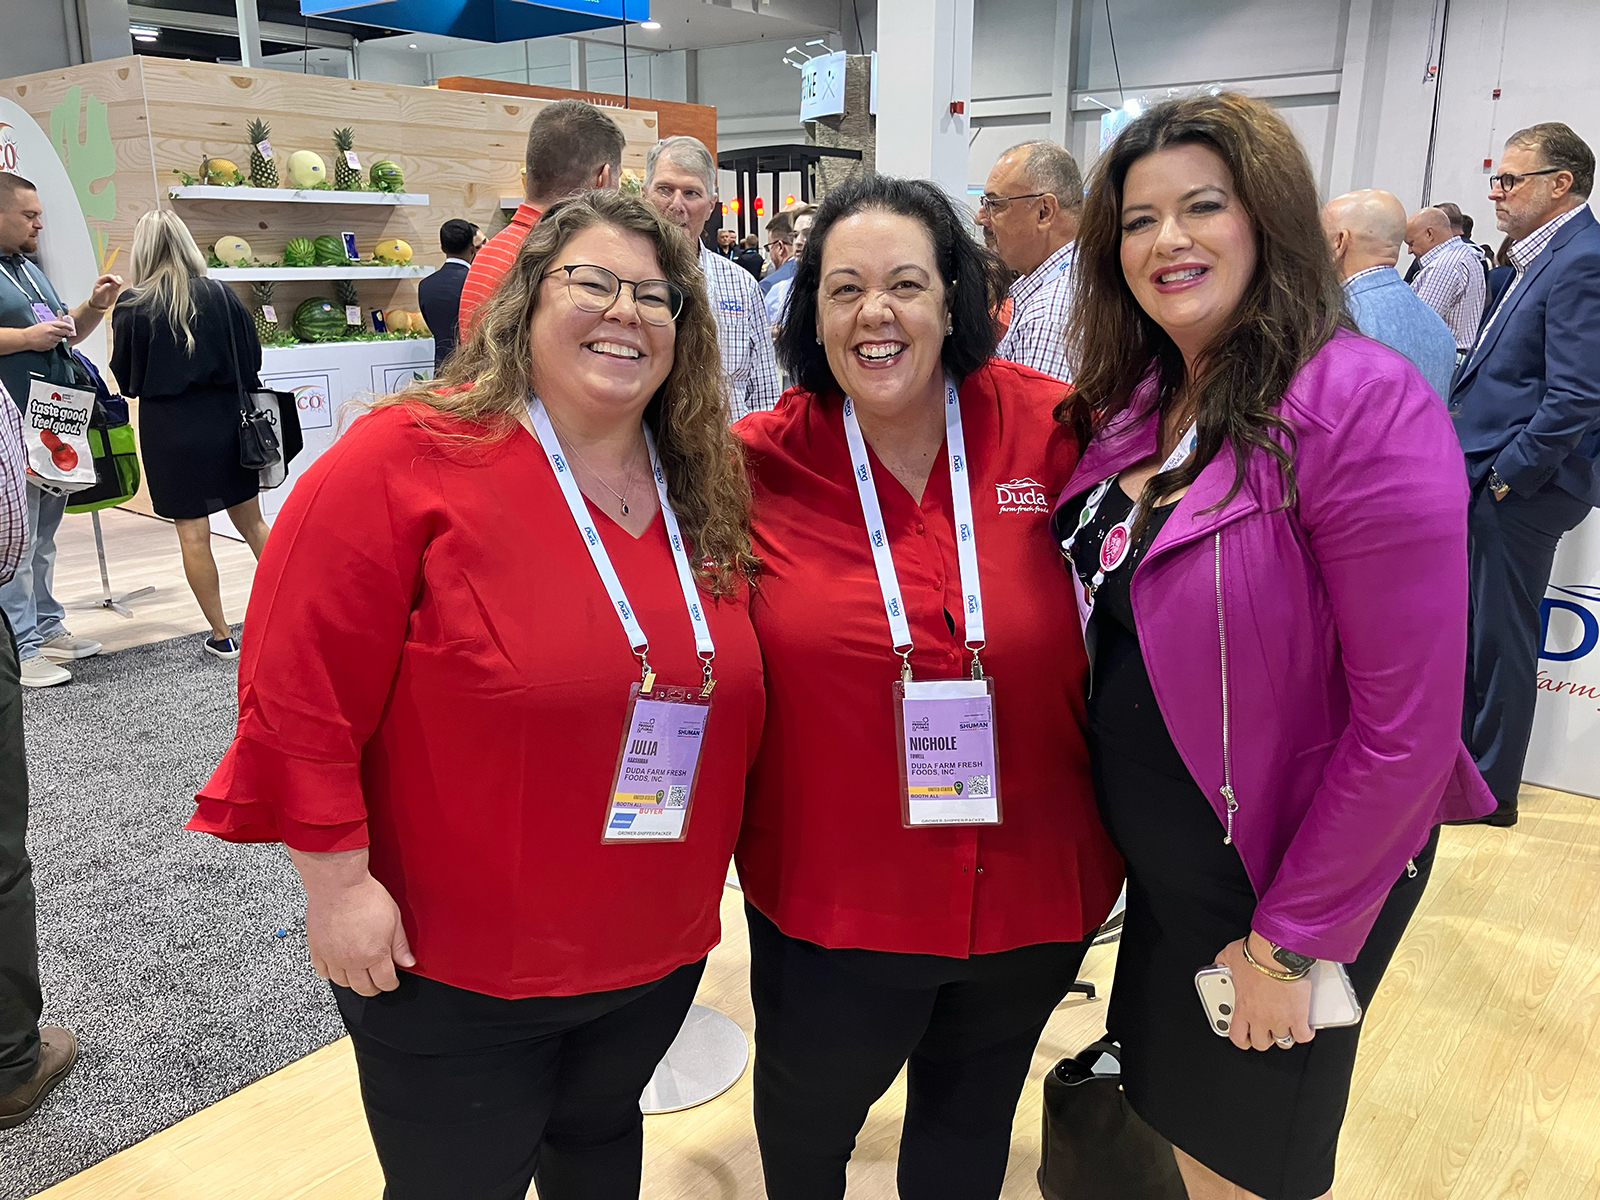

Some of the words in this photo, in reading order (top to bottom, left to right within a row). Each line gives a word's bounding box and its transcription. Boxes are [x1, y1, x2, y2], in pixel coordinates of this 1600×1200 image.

[31, 399, 59, 417] taste
[59, 408, 88, 424] good,
[32, 414, 53, 430] feel
[51, 421, 81, 436] good.
[552, 454, 564, 473] Duda
[953, 455, 961, 473] Duda
[996, 487, 1048, 506] Duda
[999, 505, 1016, 514] farm
[1016, 505, 1034, 514] fresh
[584, 527, 596, 546] Duda
[960, 524, 968, 541] Duda
[959, 722, 988, 730] SHUMAN
[629, 739, 658, 756] JULIA
[909, 736, 957, 751] NICHOLE
[624, 774, 650, 782] FOODS,
